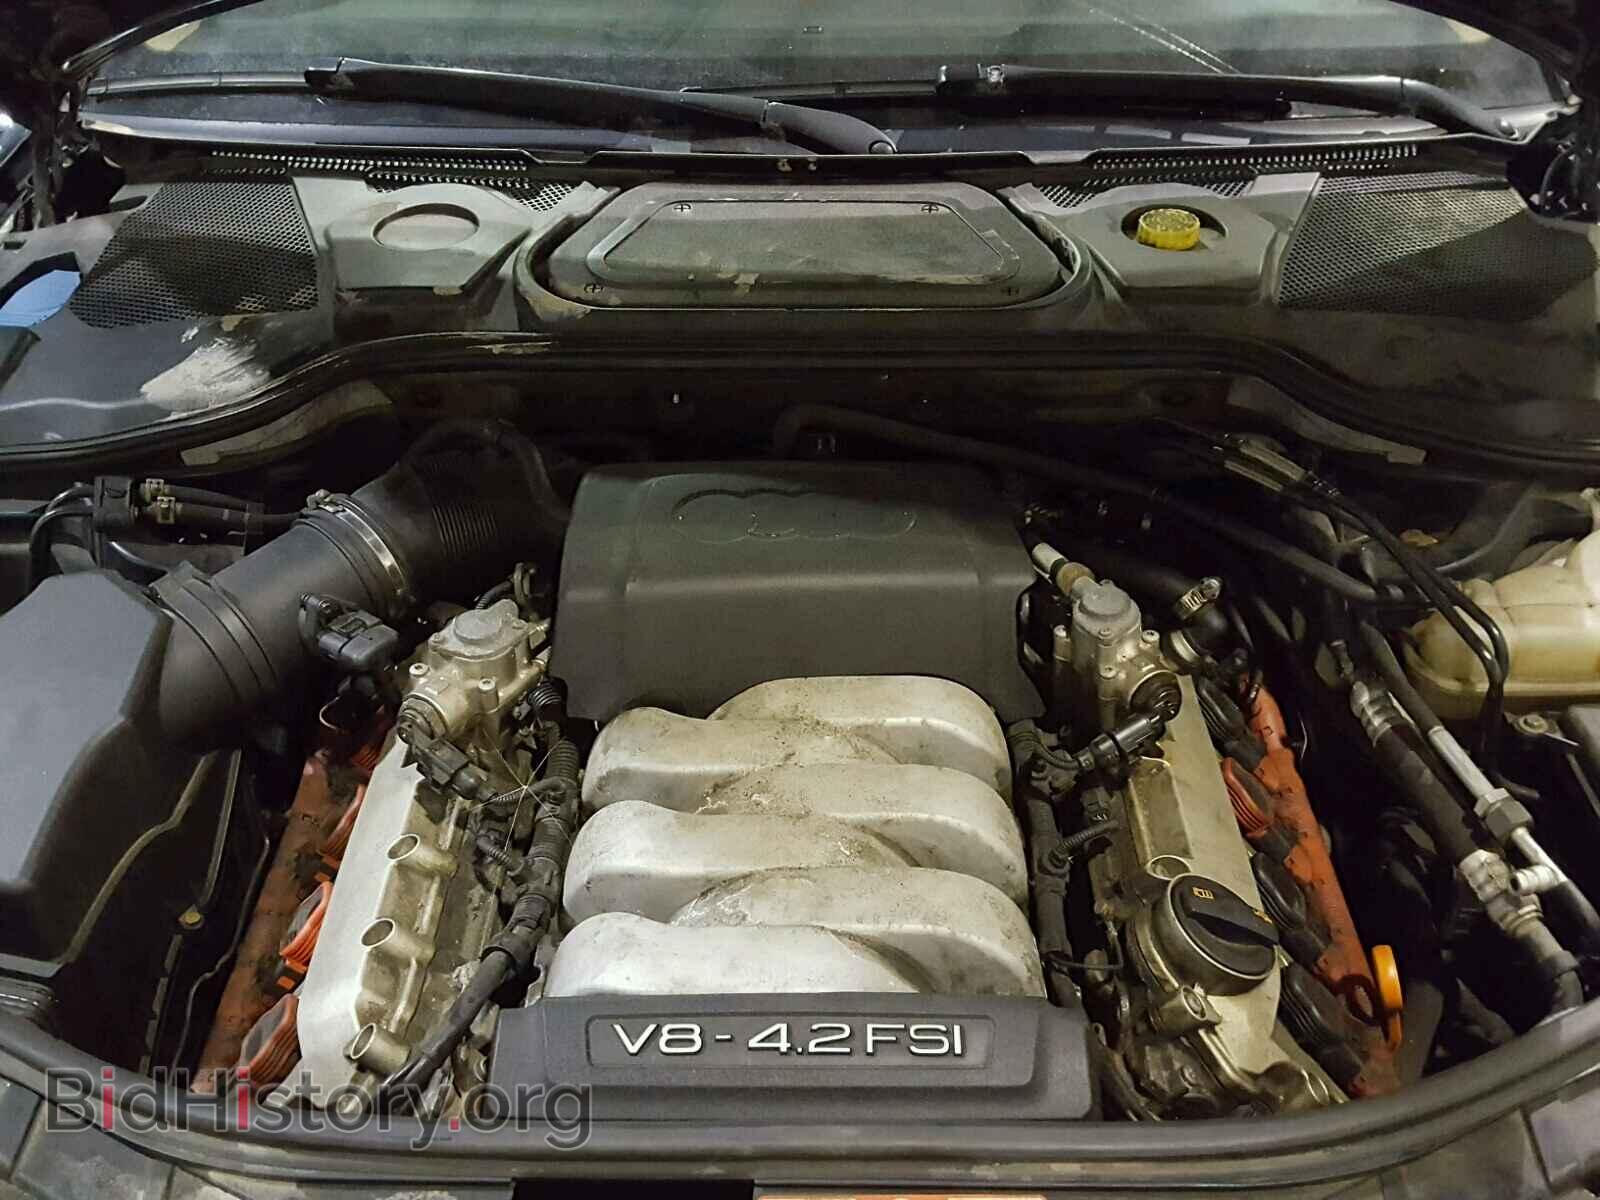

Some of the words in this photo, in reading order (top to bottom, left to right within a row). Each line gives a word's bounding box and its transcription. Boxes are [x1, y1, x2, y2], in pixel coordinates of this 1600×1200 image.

[613, 1023, 703, 1055] V8
[748, 1023, 852, 1055] 4.2
[866, 1023, 966, 1056] FSI
